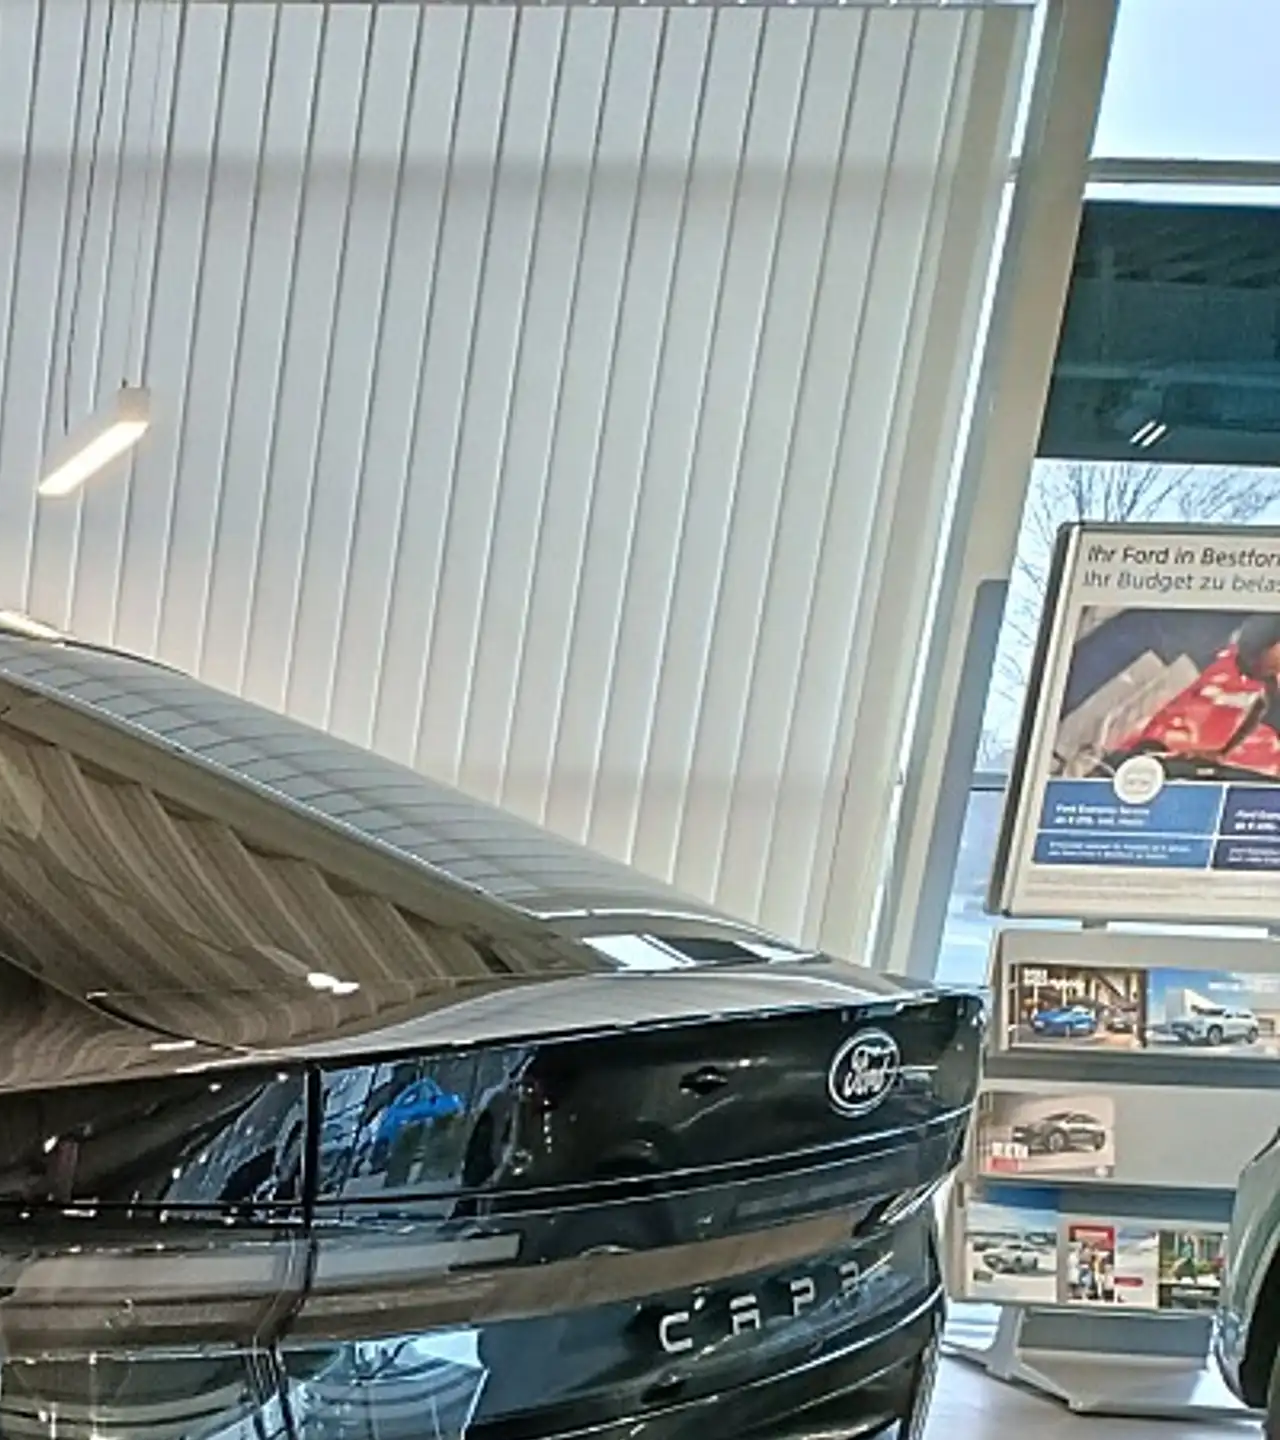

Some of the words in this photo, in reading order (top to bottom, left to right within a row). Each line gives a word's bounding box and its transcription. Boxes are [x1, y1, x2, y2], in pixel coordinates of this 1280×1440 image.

[1088, 544, 1117, 563] Ihr
[1122, 546, 1170, 565] Ford
[1174, 547, 1195, 565] in
[1082, 570, 1112, 588] Ihr
[1116, 571, 1194, 593] Budget
[1199, 576, 1224, 591] zu
[843, 1045, 890, 1098] Ford
[659, 1261, 862, 1352] CAPR
